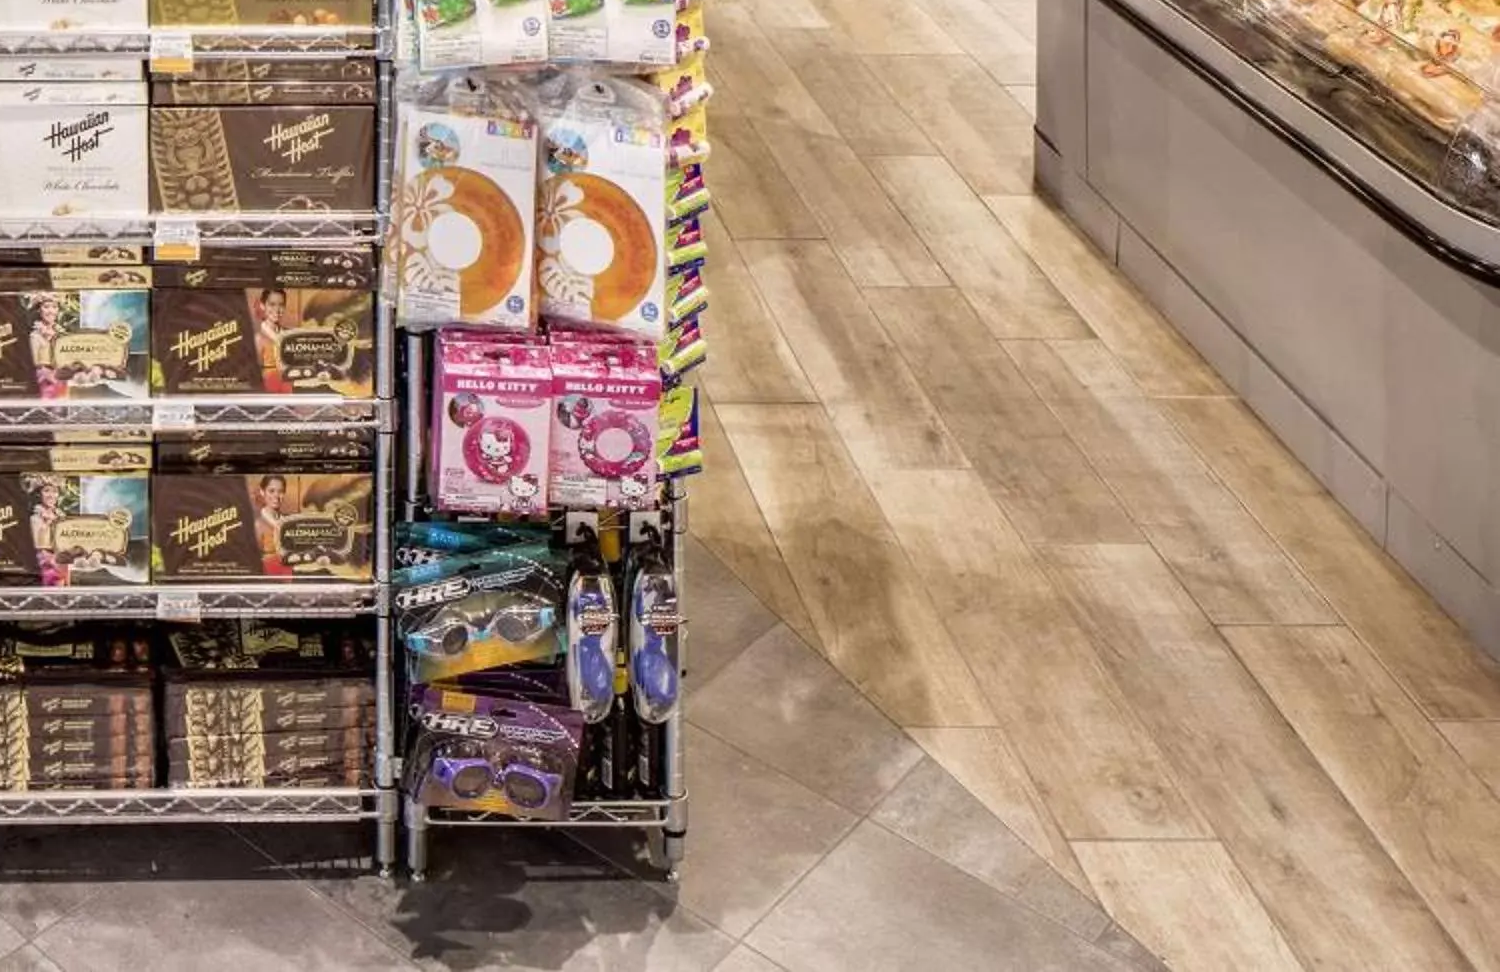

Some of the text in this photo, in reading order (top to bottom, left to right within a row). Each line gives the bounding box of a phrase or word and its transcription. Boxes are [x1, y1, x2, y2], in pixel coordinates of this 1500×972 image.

[43, 111, 109, 148] Hawaiian
[62, 127, 114, 163] Host
[263, 113, 329, 151] Hawaiian
[282, 128, 334, 164] Host
[170, 321, 237, 359] Hawaiian
[188, 336, 243, 373] Host
[456, 379, 538, 392] HELLO KITTY
[564, 381, 647, 394] HELLO KITTY
[170, 505, 237, 545] Hawaiian
[189, 521, 243, 558] Host
